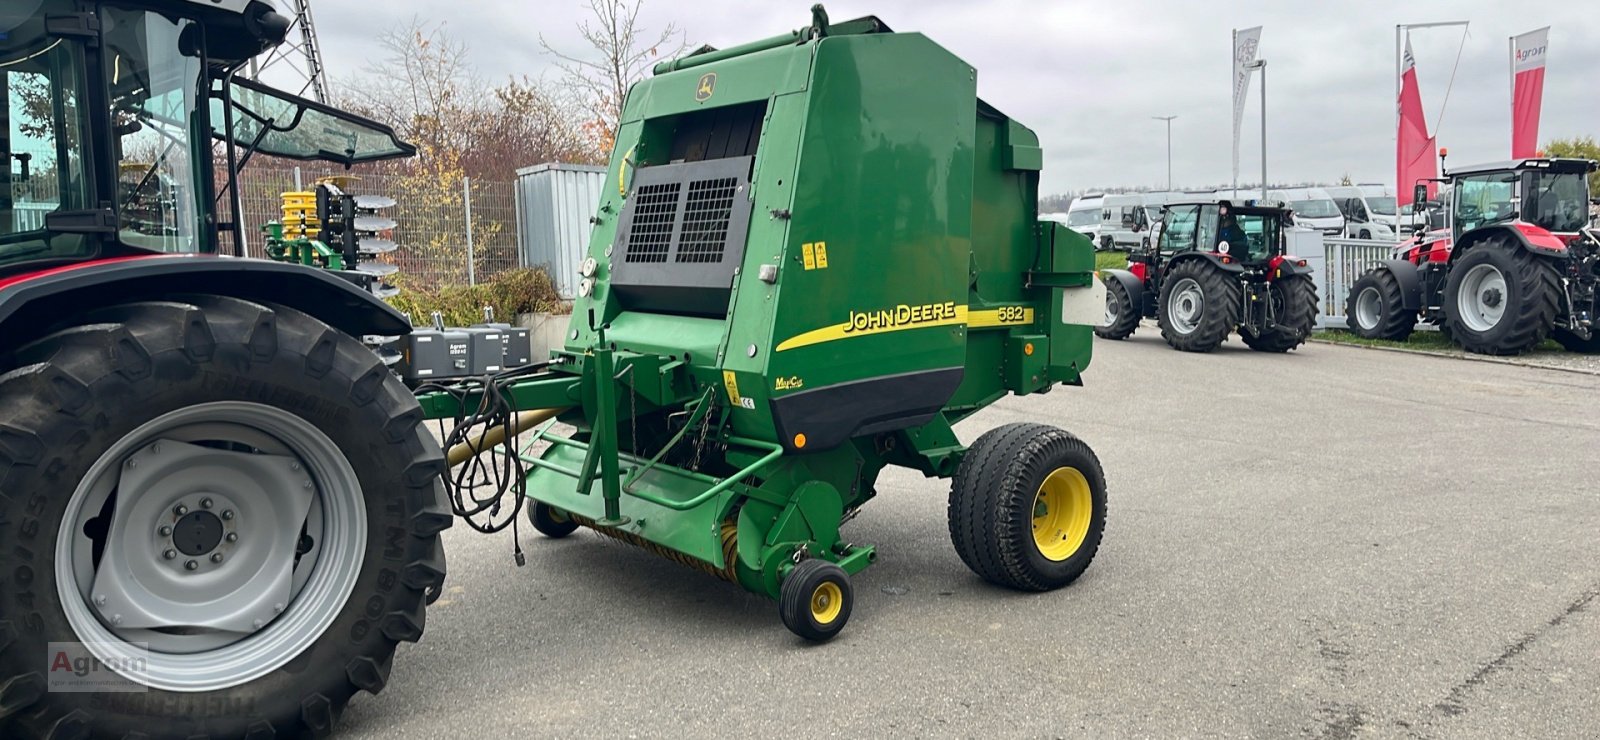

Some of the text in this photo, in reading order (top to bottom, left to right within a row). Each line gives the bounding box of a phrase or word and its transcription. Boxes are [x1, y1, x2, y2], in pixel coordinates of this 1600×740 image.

[843, 302, 955, 332] JOHN DEERE
[998, 306, 1025, 321] 582
